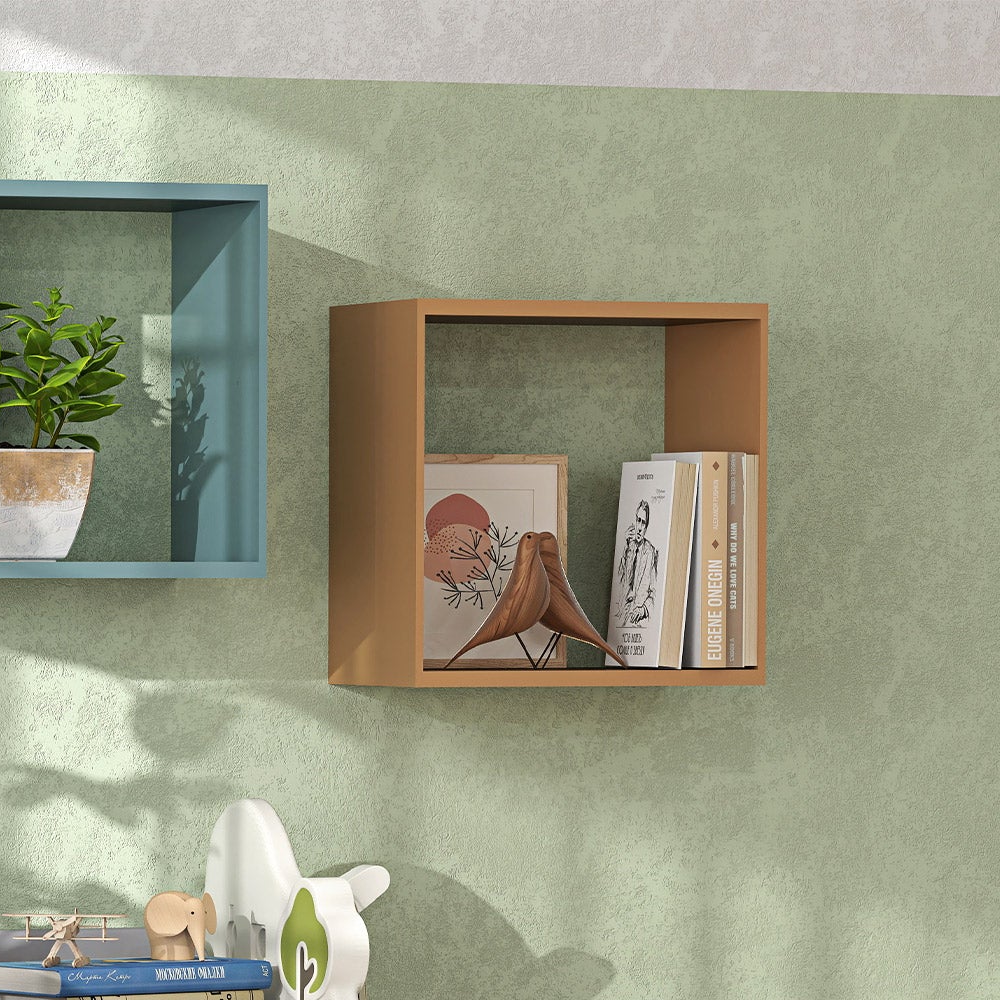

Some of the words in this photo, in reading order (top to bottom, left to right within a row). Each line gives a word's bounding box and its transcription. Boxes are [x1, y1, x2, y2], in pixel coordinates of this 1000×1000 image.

[730, 522, 738, 540] WHY
[730, 543, 737, 553] DO
[730, 556, 737, 567] WE
[708, 560, 722, 607] ONEGIN
[729, 570, 737, 588] LOVE
[729, 590, 737, 610] CATS
[708, 611, 722, 660] EUGENE
